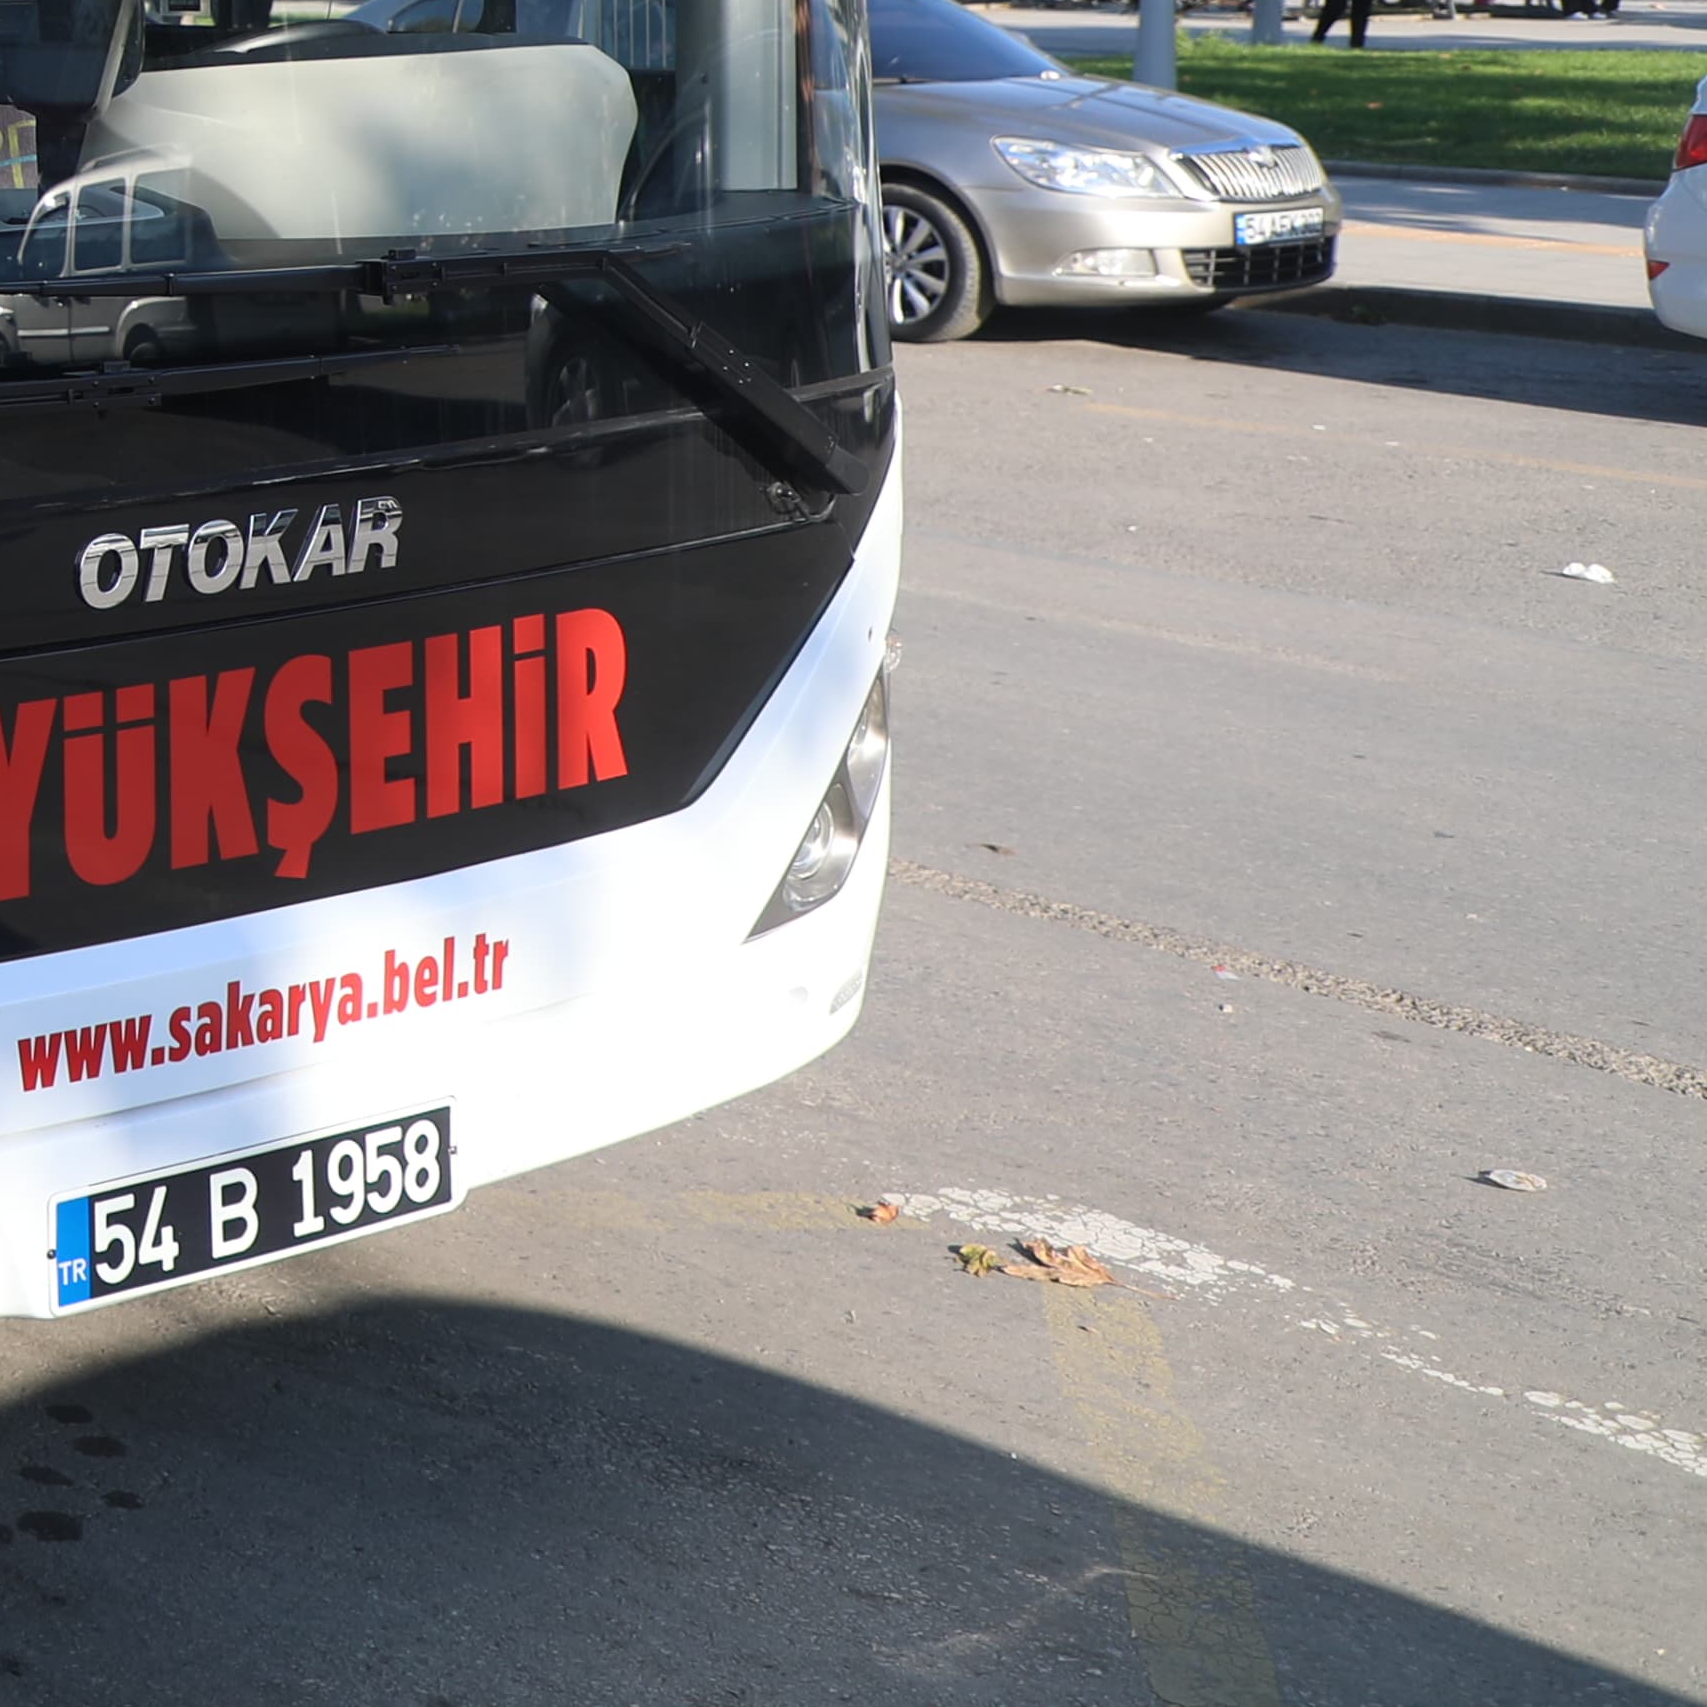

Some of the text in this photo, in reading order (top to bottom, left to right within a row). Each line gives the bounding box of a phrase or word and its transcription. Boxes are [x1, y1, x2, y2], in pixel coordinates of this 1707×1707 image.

[76, 495, 403, 610] OTOKAR
[17, 933, 510, 1092] www.sakarya.bel.tr
[58, 1119, 441, 1286] TR 54 B 1958
